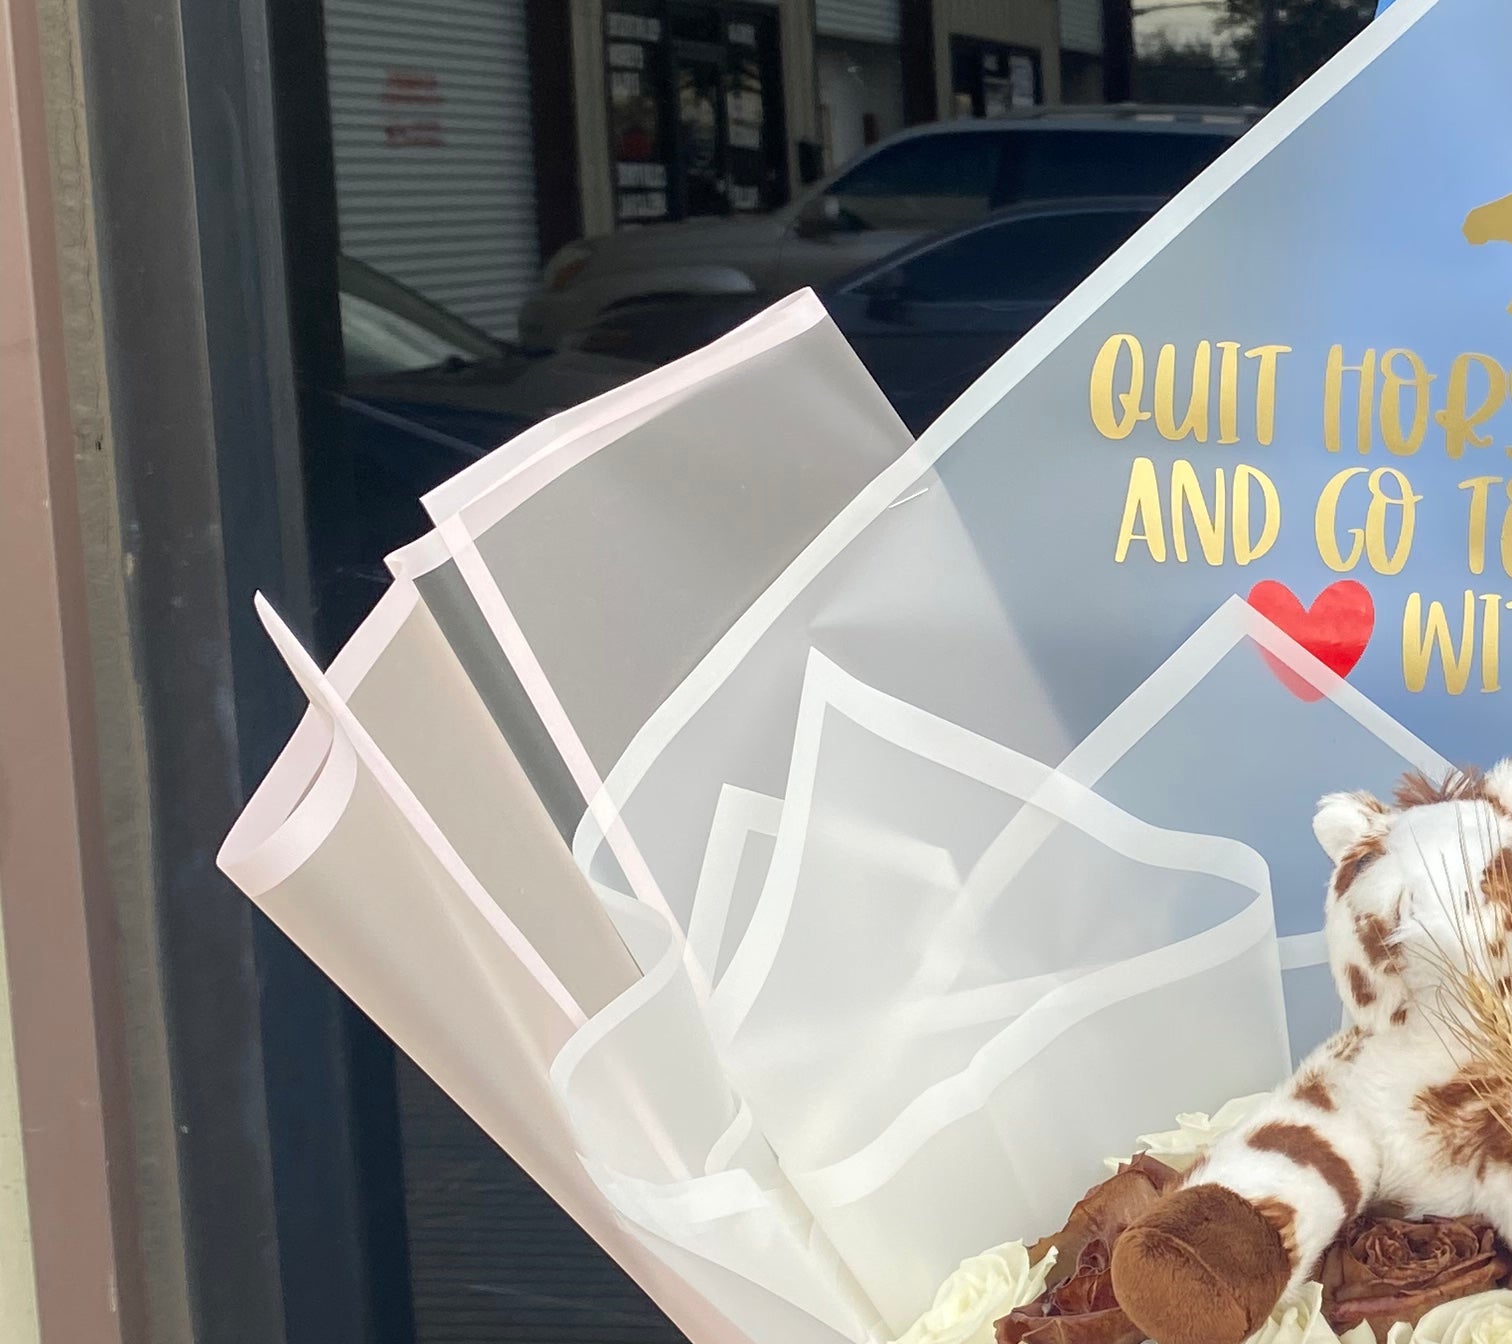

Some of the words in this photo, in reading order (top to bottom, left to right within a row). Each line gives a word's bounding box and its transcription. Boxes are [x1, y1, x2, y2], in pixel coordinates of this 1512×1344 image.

[1089, 333, 1291, 446] QUIT
[1114, 457, 1281, 566] AND
[1314, 467, 1421, 576] GO
